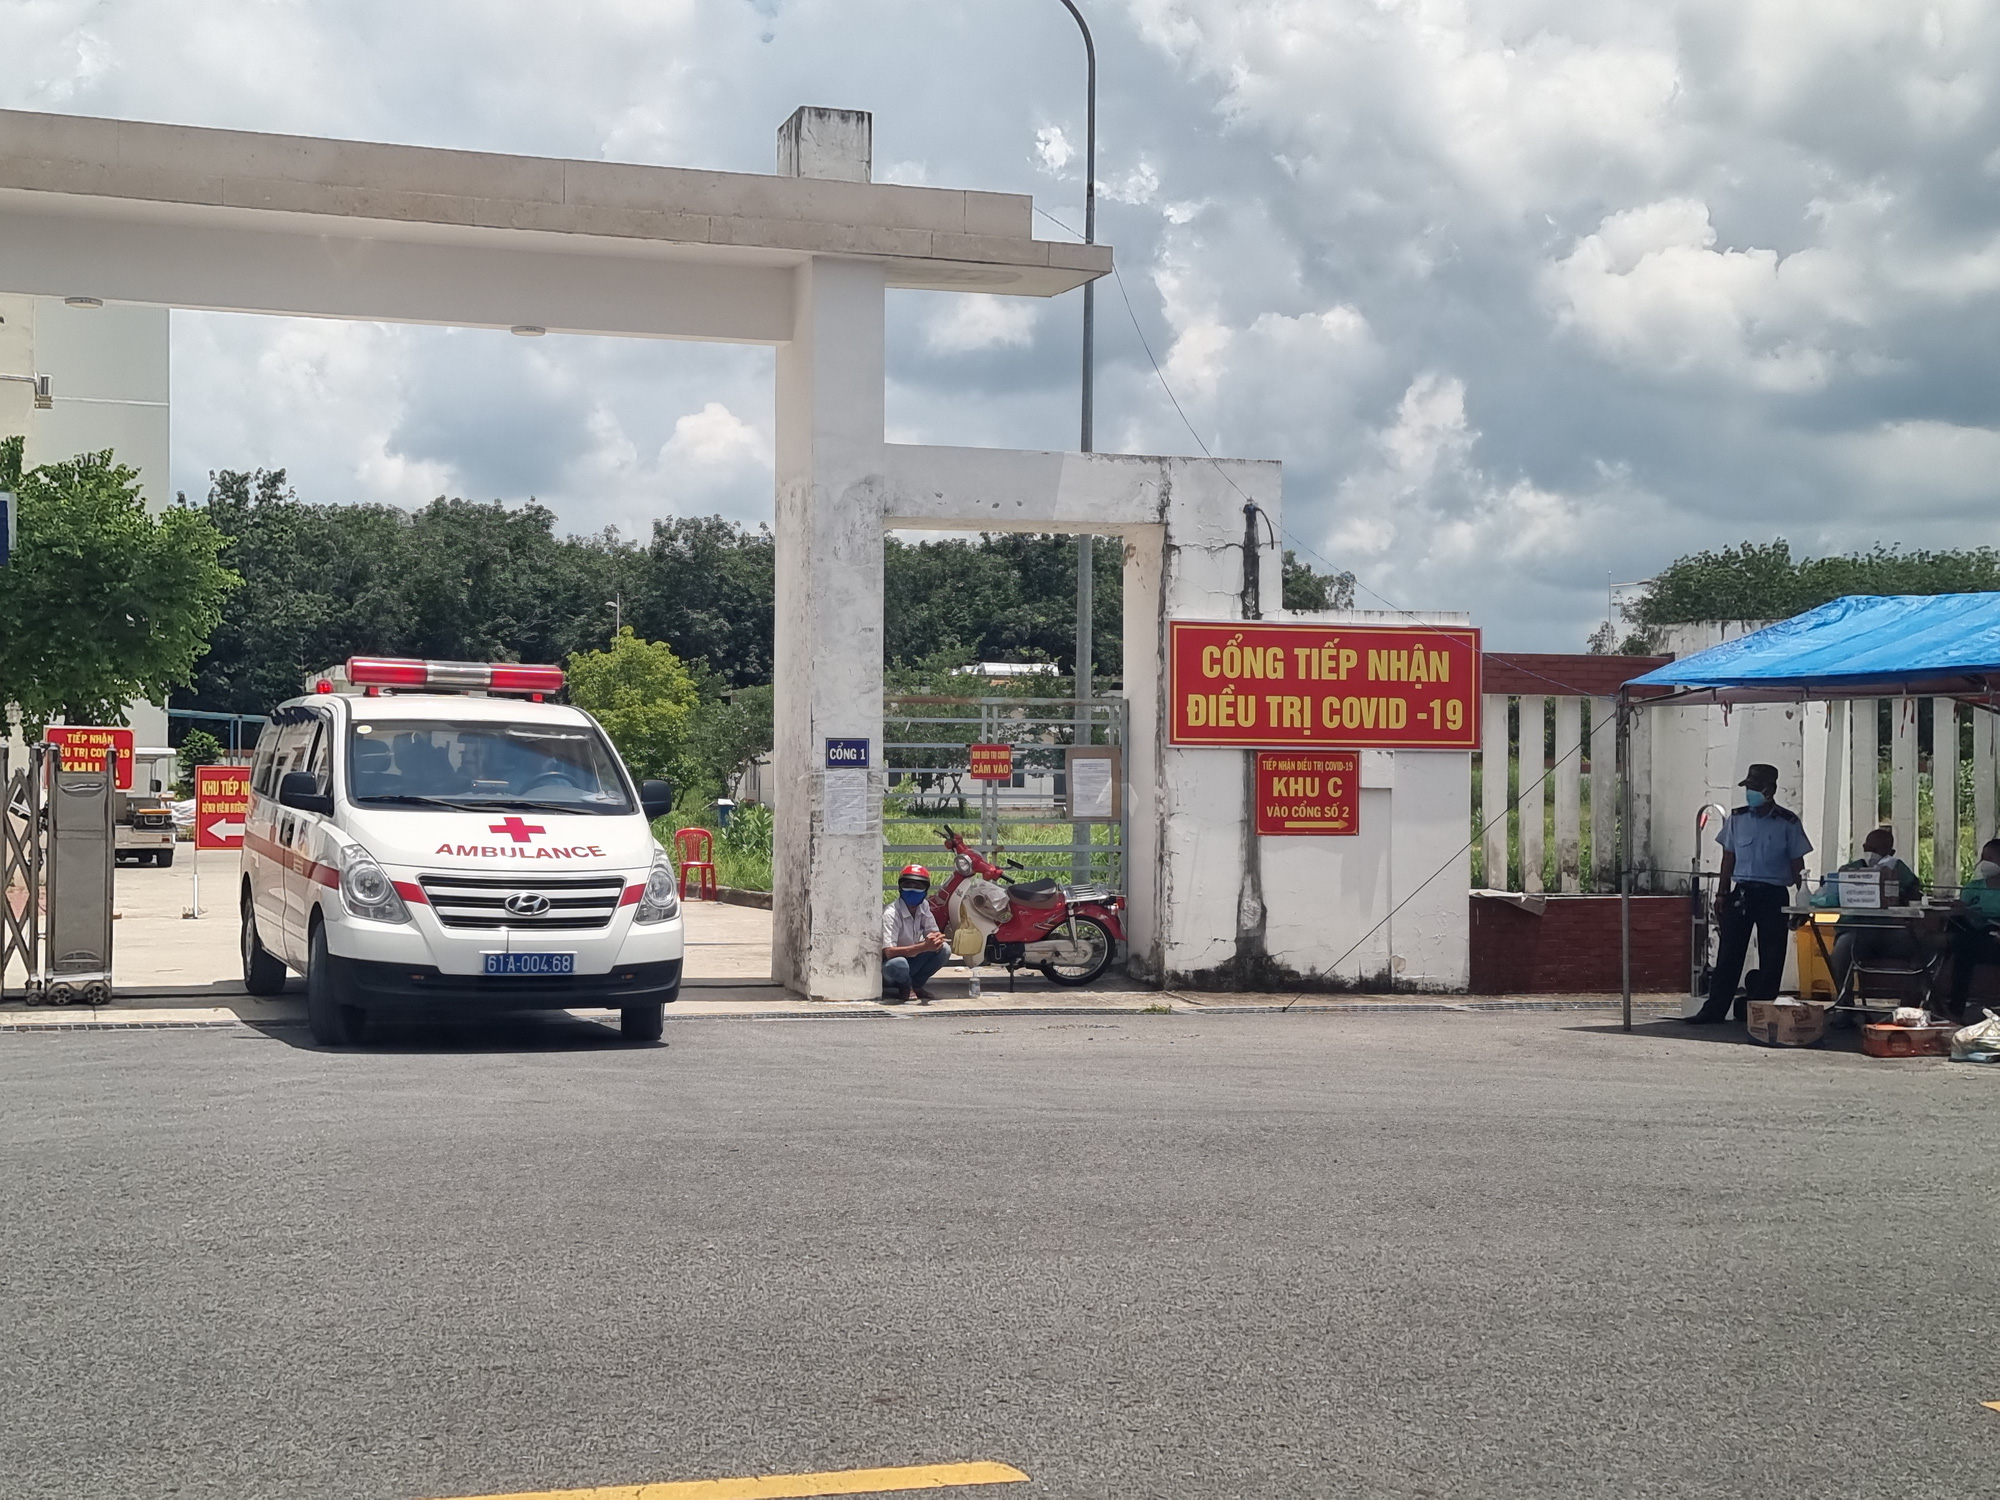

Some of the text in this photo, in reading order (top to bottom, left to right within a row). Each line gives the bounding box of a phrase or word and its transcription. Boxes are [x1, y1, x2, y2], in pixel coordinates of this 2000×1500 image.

[1202, 633, 1450, 690] CỔNG TIẾP NHẬN
[1186, 684, 1463, 736] ĐIỀU TRỊ COVID -19
[66, 731, 114, 746] TIẾP NHẬN
[73, 747, 88, 759] TRỊ
[829, 742, 866, 760] CỔNG 1
[973, 761, 1009, 774] CẤM VÀO
[1262, 757, 1277, 771] TIẾP
[1278, 758, 1296, 772] NHẬN
[1313, 761, 1324, 773] TRỊ
[1325, 761, 1353, 771] COVID-19
[202, 780, 220, 796] KHU
[220, 775, 240, 796] TIẾP
[1273, 777, 1343, 798] KHU C
[1266, 800, 1350, 818] VÀO CỔNG SỐ 2
[435, 843, 607, 859] AMBULANCE
[487, 955, 571, 973] 61A-004.68
